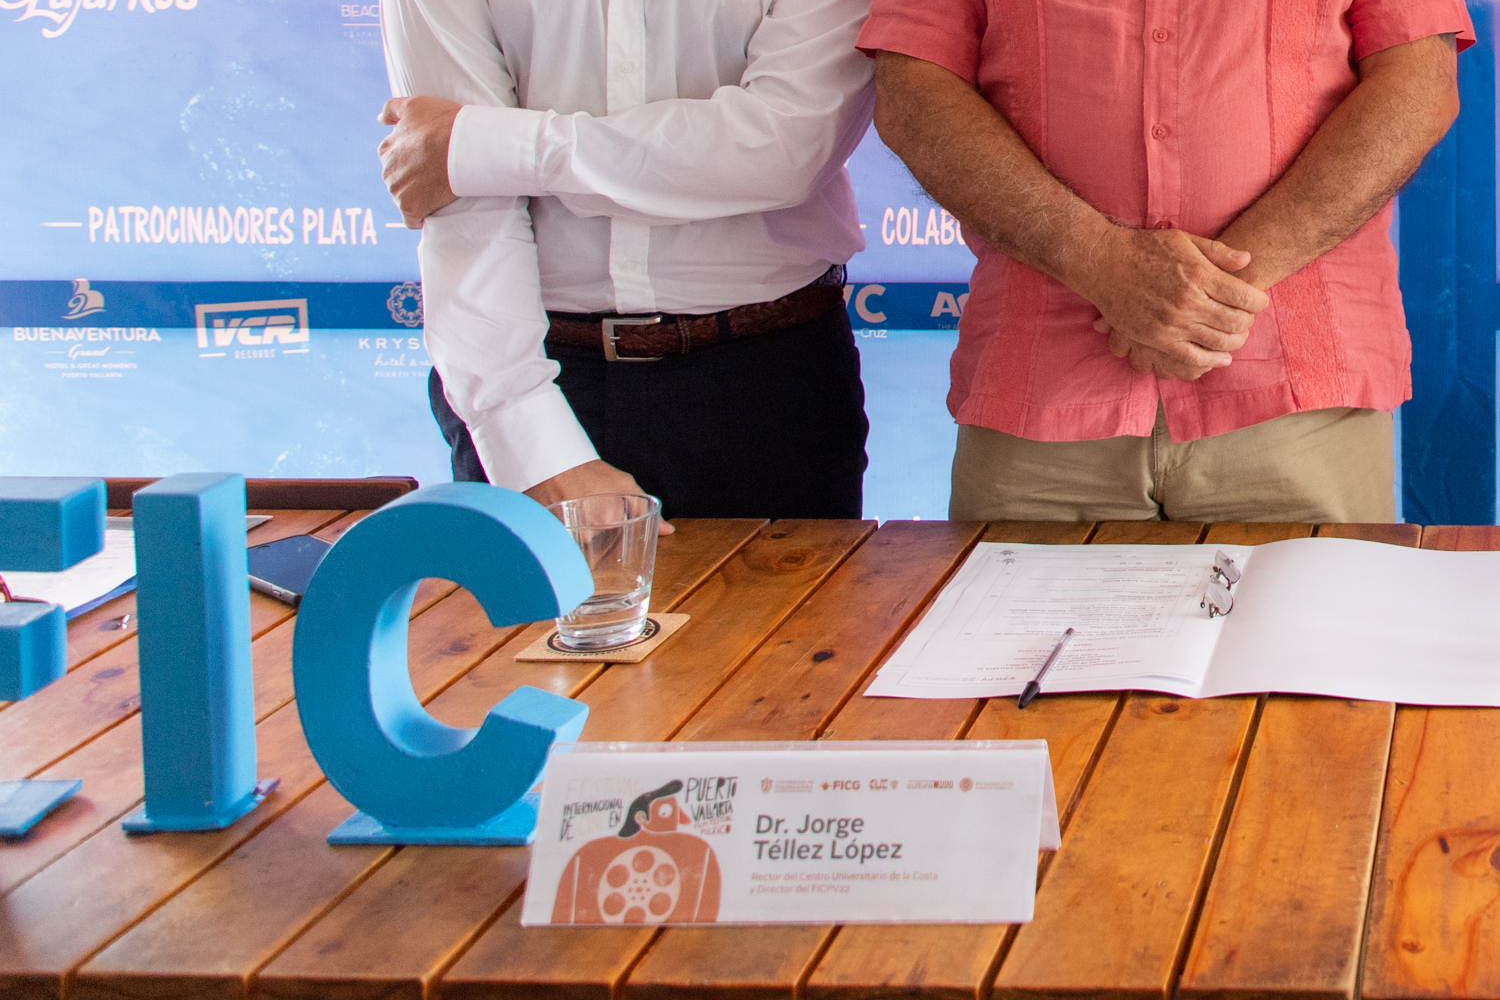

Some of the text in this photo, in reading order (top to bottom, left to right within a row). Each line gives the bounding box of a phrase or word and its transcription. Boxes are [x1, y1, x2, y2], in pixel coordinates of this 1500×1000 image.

[88, 205, 377, 246] PATROCINADORES PLATA
[13, 327, 161, 341] BUENAVENTURA
[213, 315, 302, 346] VCR
[67, 344, 111, 360] Grand
[234, 350, 276, 359] RECORDS
[833, 780, 861, 791] FICG
[755, 814, 865, 839] Dr. Jorge
[753, 838, 903, 864] Téllez López
[752, 871, 938, 881] Rector del Centro Universitario de la Costa
[757, 884, 793, 894] Director
[796, 884, 810, 893] del
